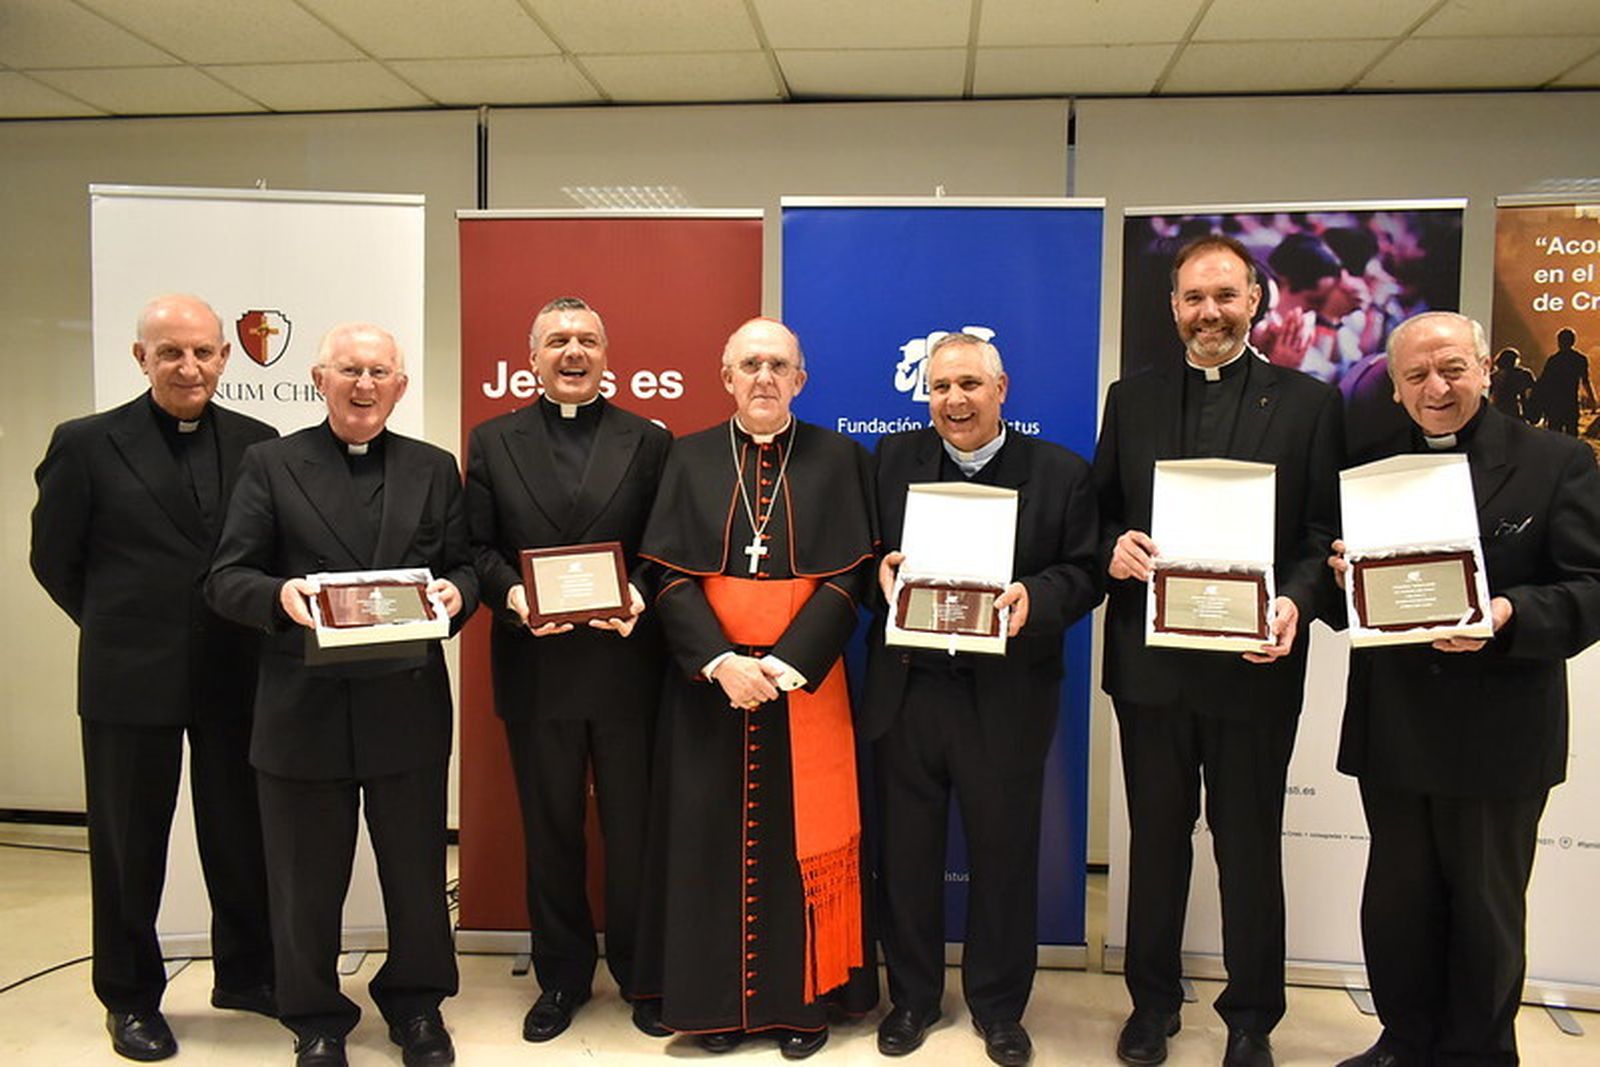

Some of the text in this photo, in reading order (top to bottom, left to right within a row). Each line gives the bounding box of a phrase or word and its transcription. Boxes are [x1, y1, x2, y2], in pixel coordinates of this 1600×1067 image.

[1535, 236, 1600, 255] “Aco
[1533, 263, 1594, 284] en el
[1532, 292, 1565, 312] de
[630, 369, 684, 399] es
[837, 417, 922, 434] Fundación
